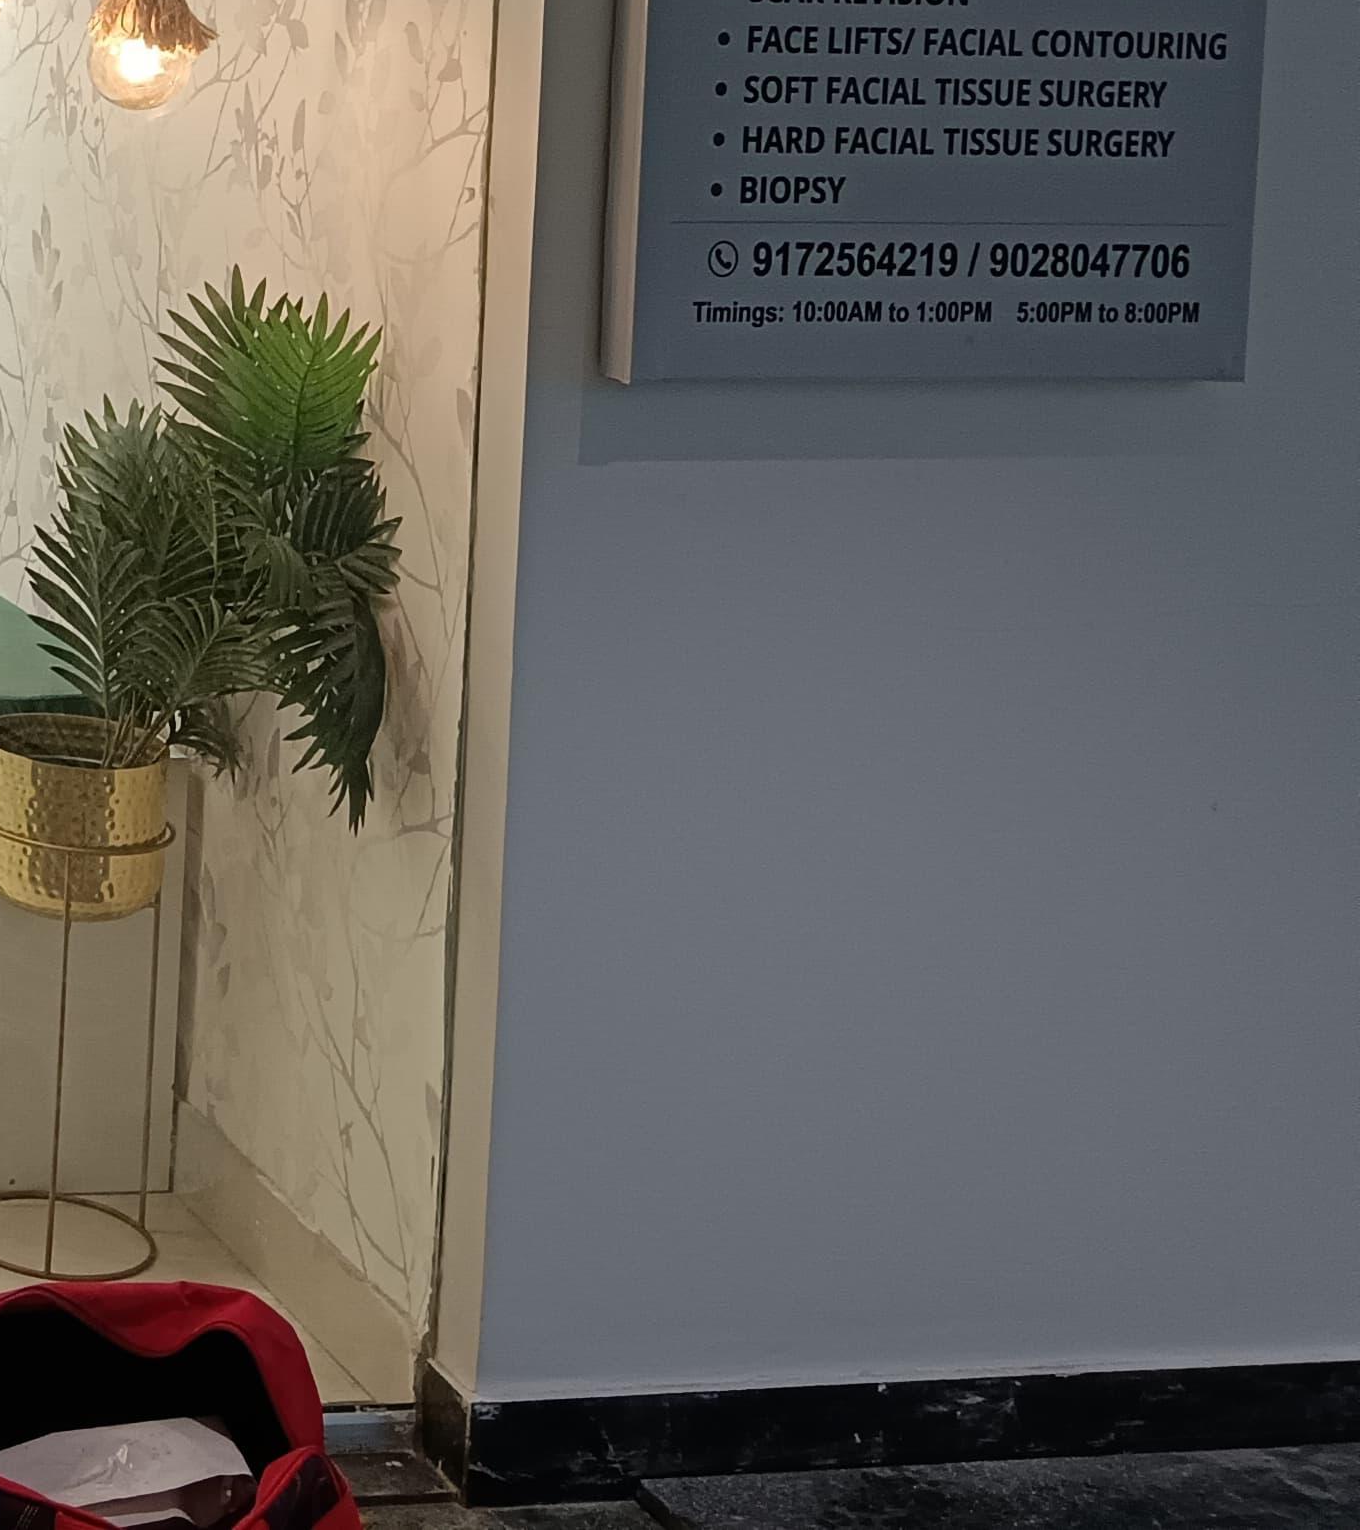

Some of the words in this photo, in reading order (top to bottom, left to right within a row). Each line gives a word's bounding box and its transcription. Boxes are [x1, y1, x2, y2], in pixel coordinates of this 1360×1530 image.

[748, 26, 818, 53] FACE
[828, 27, 915, 55] LIFTS/
[924, 29, 1022, 56] FACIAL
[1032, 30, 1226, 60] CONTOURING
[744, 76, 818, 103] SOFT
[827, 77, 926, 105] FACIAL
[935, 79, 1031, 106] TISSUE
[1039, 80, 1167, 108] SURGERY
[743, 126, 824, 153] HARD
[835, 127, 934, 155] FACIAL
[944, 128, 1039, 155] TISSUE
[1047, 129, 1174, 157] SURGERY
[741, 177, 846, 203] BIOPSY
[754, 242, 957, 276] 9172564219
[991, 243, 1189, 278] 9028047706
[693, 302, 783, 327] Timings:
[793, 301, 882, 322] 10:00AM
[889, 303, 909, 322] to
[917, 302, 991, 322] 1:00PM
[1017, 302, 1092, 322] 5:00PM
[1099, 304, 1118, 323] to
[1125, 302, 1199, 323] 8:00PM
